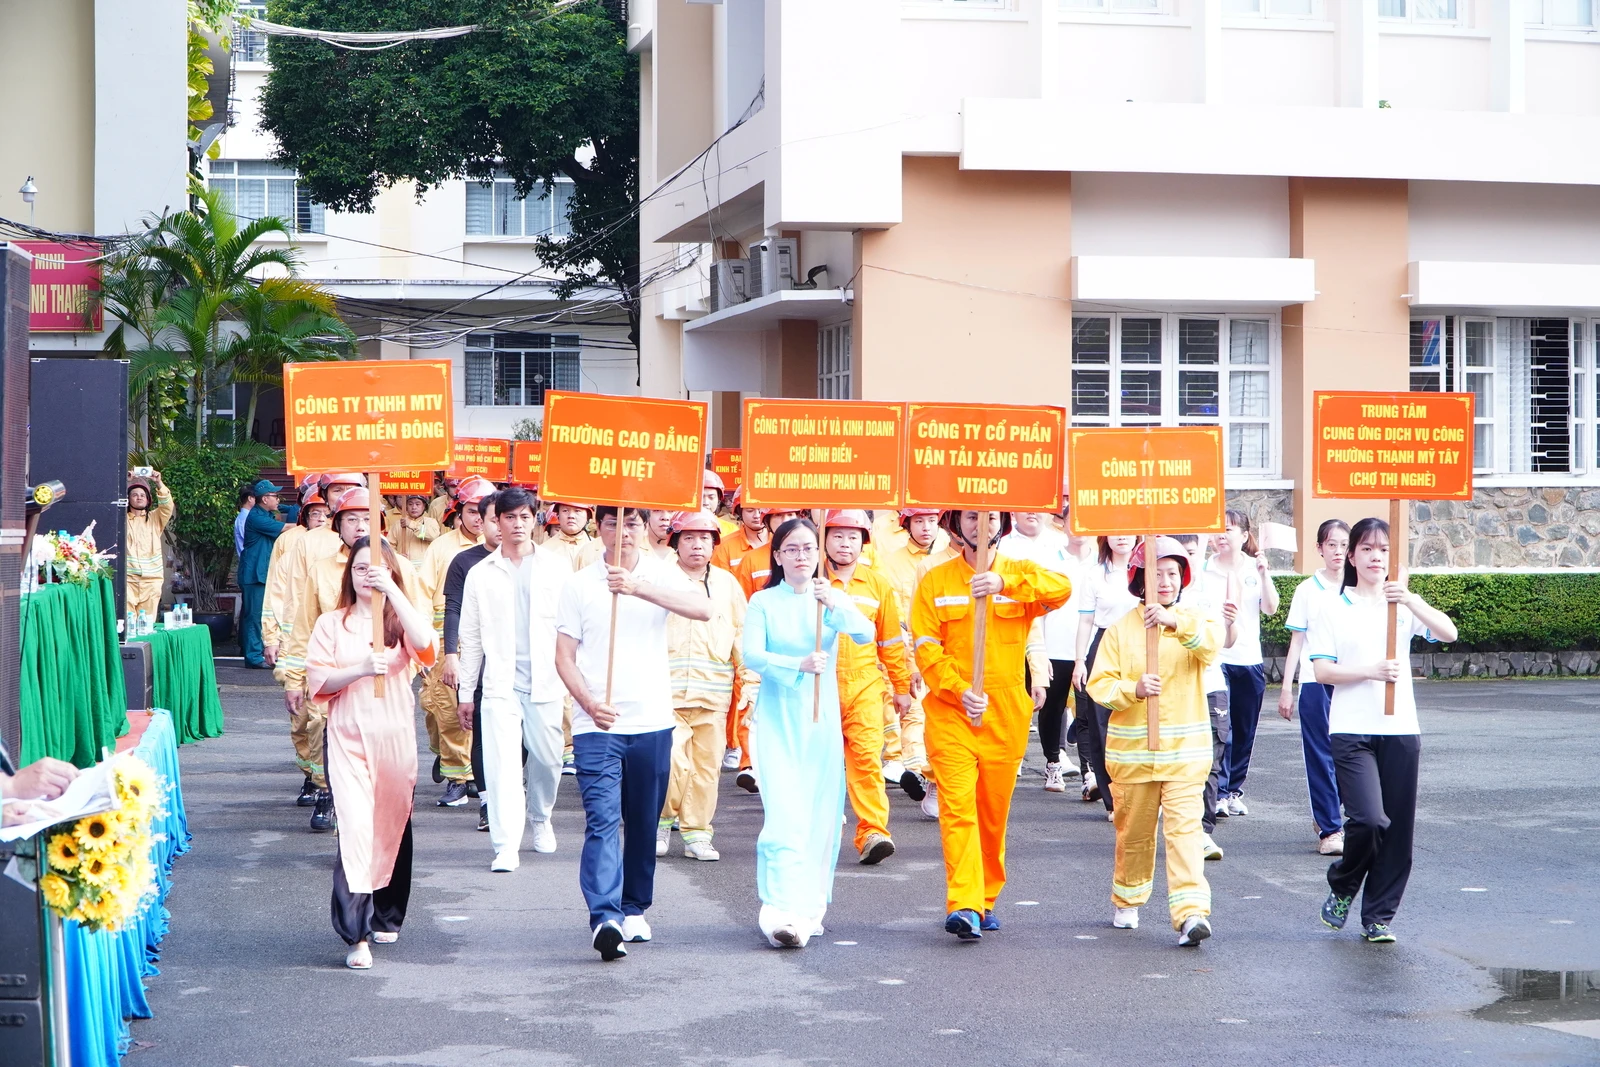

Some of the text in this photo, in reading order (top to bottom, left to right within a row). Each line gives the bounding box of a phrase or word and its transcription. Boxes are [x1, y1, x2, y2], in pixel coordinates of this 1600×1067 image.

[35, 254, 64, 270] MINH
[30, 284, 88, 320] NH THẠNH
[295, 394, 443, 414] CÔNG TY TNHH MTV
[1361, 402, 1427, 419] TRUNG TÂM
[296, 418, 444, 442] BẾN XE MIỀN ĐÔNG
[754, 414, 894, 436] CÔNG TY QUẢN LÝ VÀ KINH DOANH
[917, 419, 1052, 442] CÔNG TY CỔ PHẦN
[1323, 424, 1464, 444] CUNG ỨNG DỊCH VỤ CÔNG
[475, 444, 488, 452] CÔNG
[551, 423, 699, 453] TRƯỜNG CAO ĐẲNG
[493, 456, 506, 464] MINH
[790, 445, 807, 466] CHỢ
[809, 443, 830, 462] BÌNH
[914, 445, 1053, 469] VẬN TẢI XĂNG DẦU
[1327, 447, 1460, 466] PHƯỜNG THẠNH MỸ TÂY
[589, 457, 656, 481] ĐẠI VIỆT
[1102, 457, 1192, 477] CÔNG TY TNHH
[379, 482, 399, 490] THANH
[410, 482, 425, 490] VIEW
[754, 466, 891, 494] ĐIỂM KINH DOANH PHAN VĂN TRỊ
[957, 477, 1008, 494] VITACO
[1350, 470, 1436, 488] (CHỢ THỊ NGHÈ)
[1078, 487, 1216, 506] MH PROPERTIES CORP
